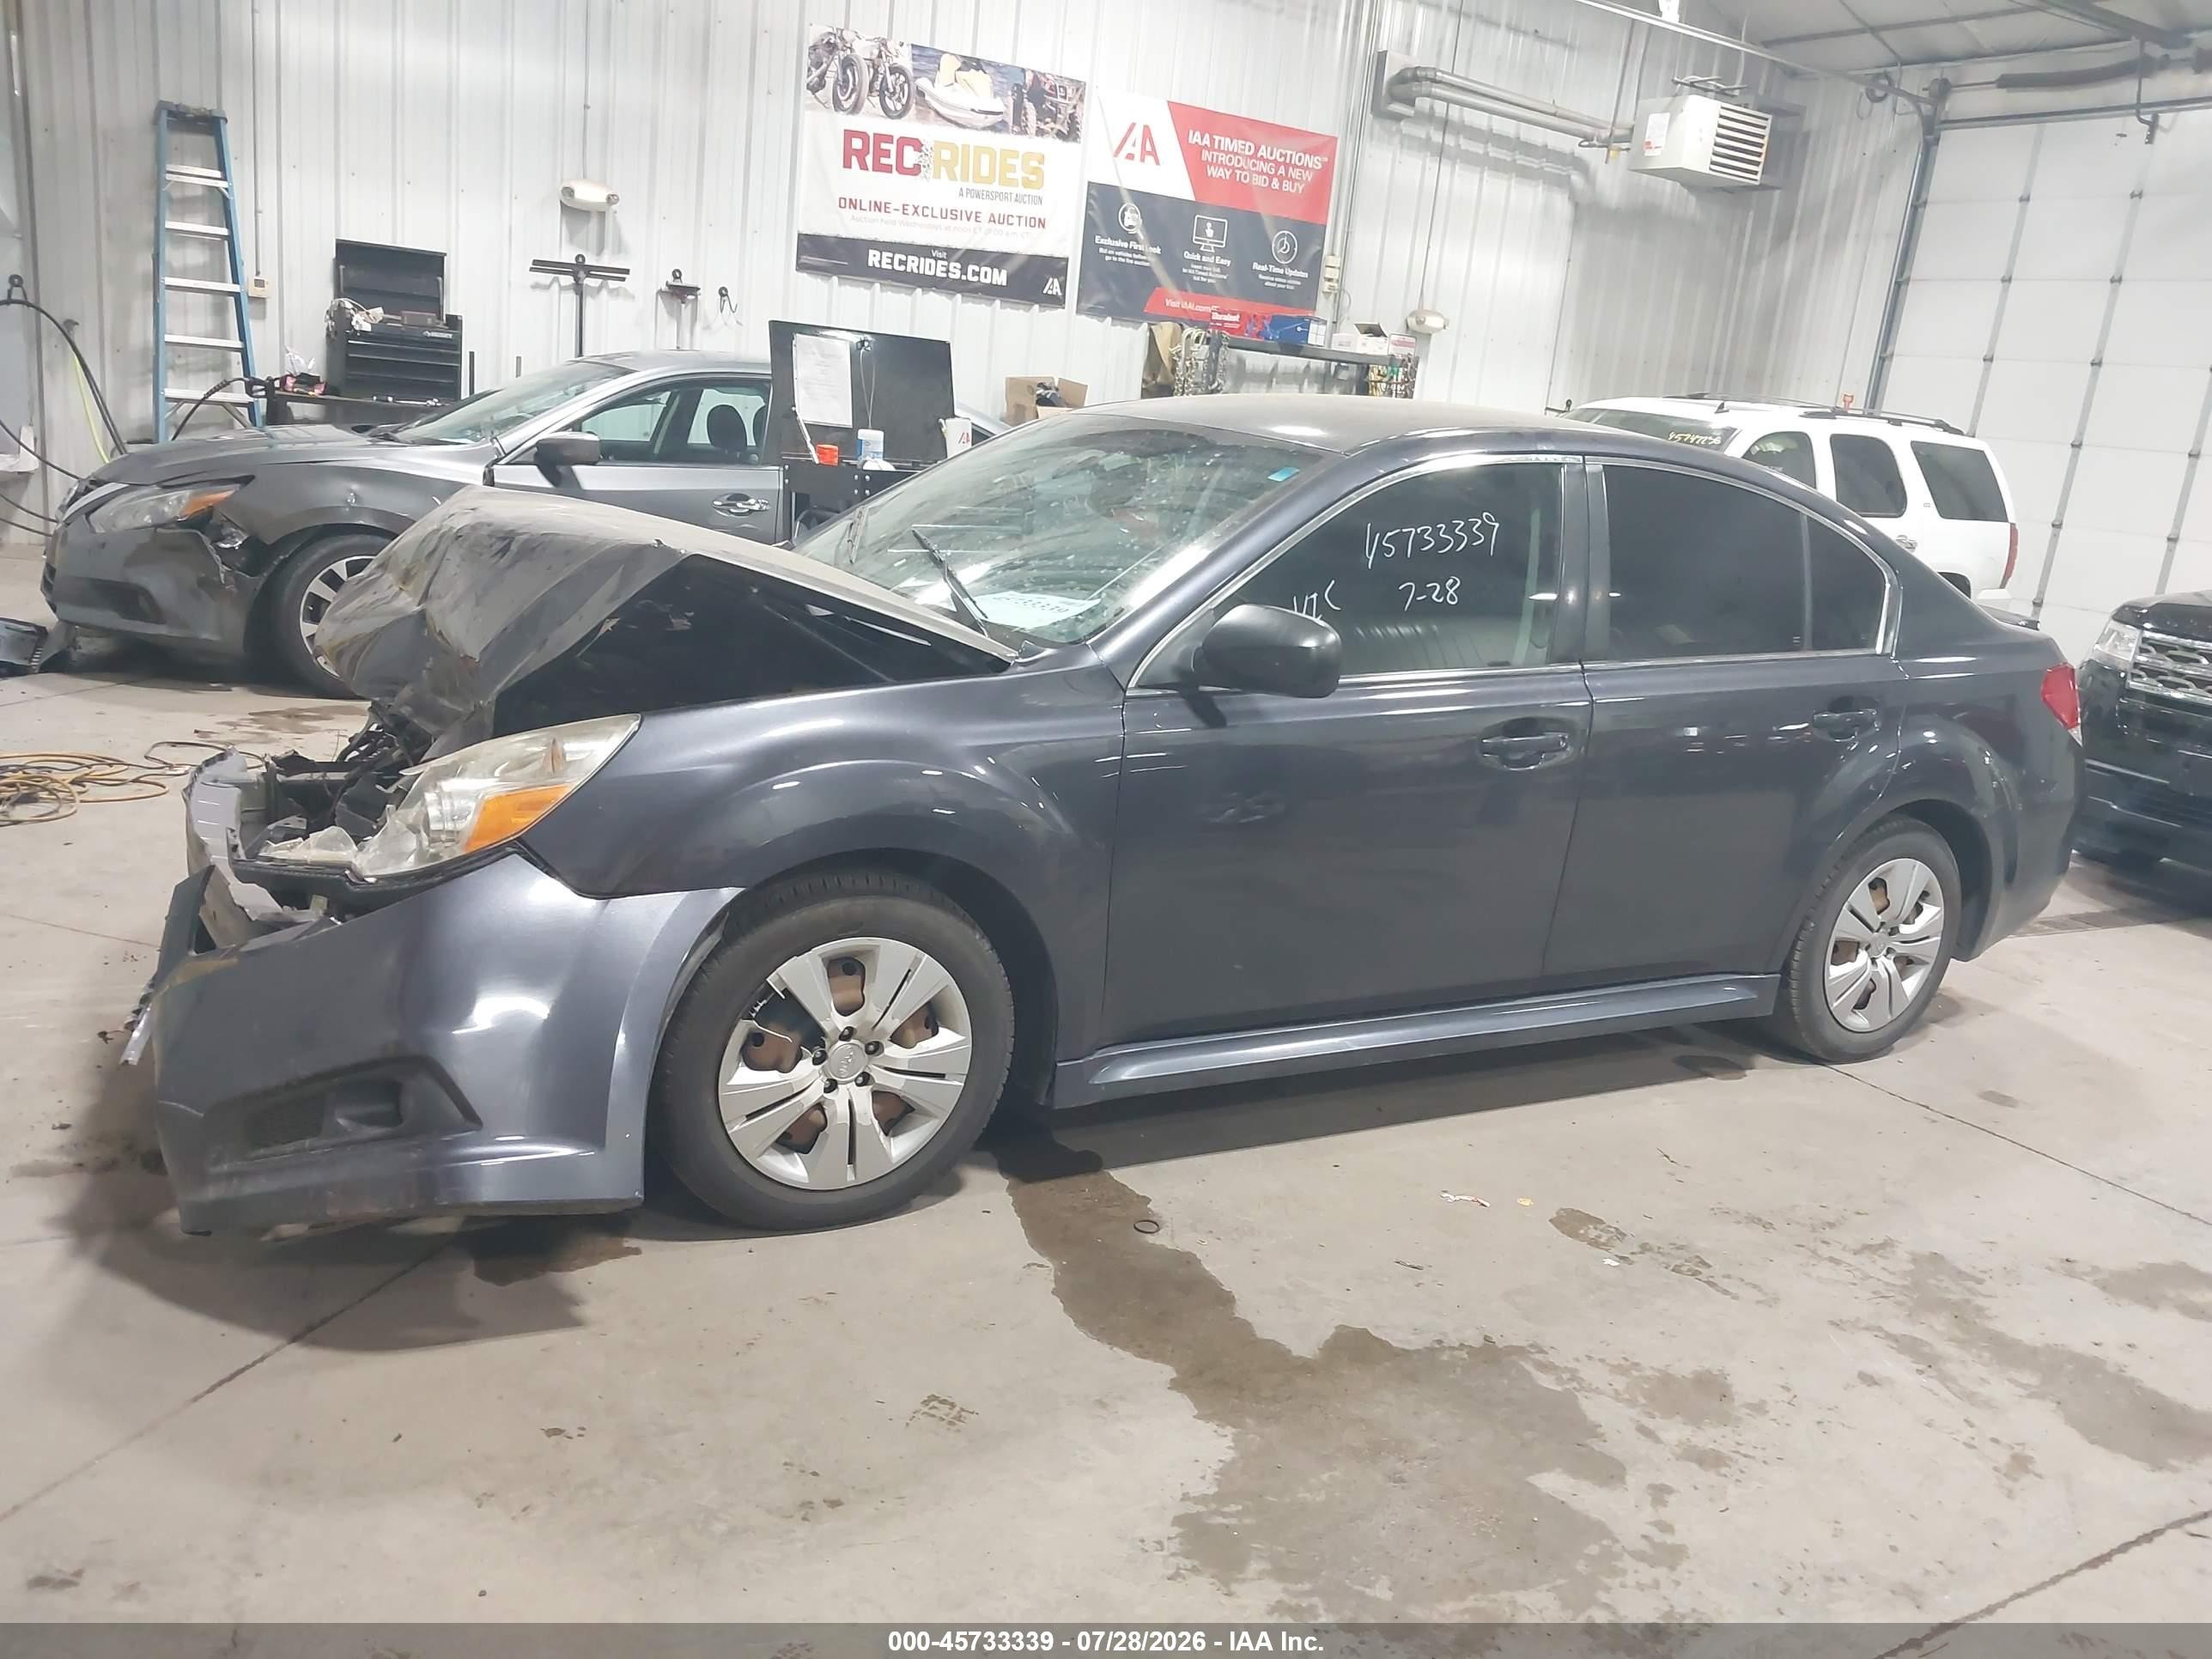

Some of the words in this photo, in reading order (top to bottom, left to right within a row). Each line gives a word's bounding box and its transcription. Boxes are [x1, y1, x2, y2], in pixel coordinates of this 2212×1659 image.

[1188, 130, 1211, 149] IAA
[1212, 135, 1255, 155] TIMED
[1201, 150, 1275, 175] INTRODUCING
[1278, 164, 1286, 176] A
[1288, 166, 1313, 182] NEW
[1206, 165, 1233, 180] WAY
[1235, 169, 1250, 183] TO
[1252, 173, 1269, 188] BID
[1271, 177, 1280, 190] &
[1282, 179, 1305, 194] BUY
[958, 187, 964, 198] A
[965, 188, 1013, 203] POWERSPORT
[1014, 193, 1043, 206] AUCTION
[838, 197, 981, 223] ONLINE-EXCLUSIVE
[988, 213, 1047, 229] AUCTION
[931, 249, 947, 259] Visit
[1095, 234, 1128, 249] Exclusive
[867, 248, 1008, 287] RECRIDES.COM
[1183, 251, 1201, 261] Quick
[1215, 256, 1231, 267] Easy
[1252, 262, 1285, 274] Real-Time
[1285, 267, 1309, 278] Updates
[1365, 512, 1499, 569] 45733339
[1399, 576, 1461, 611] 7-28
